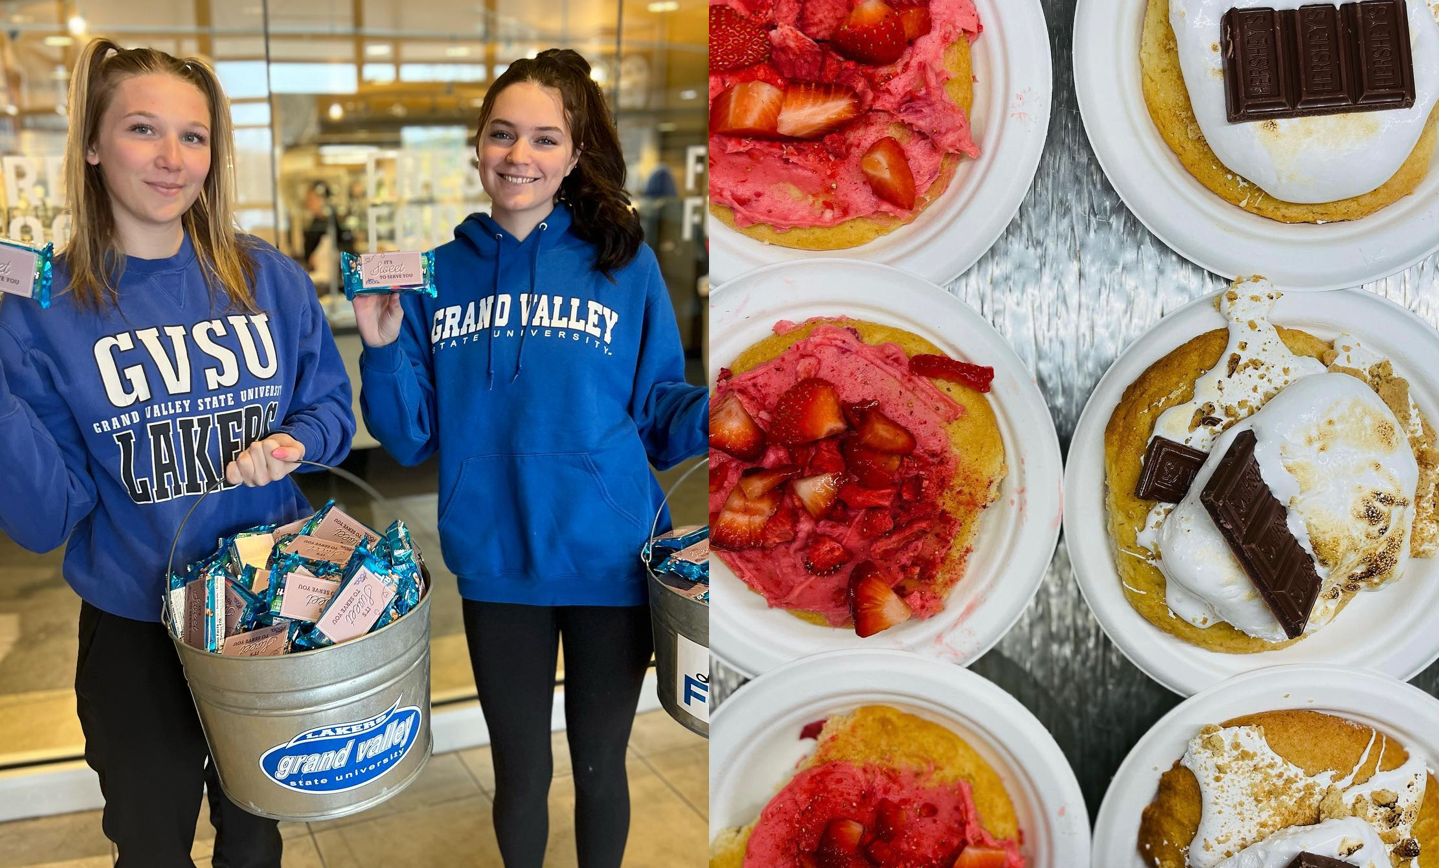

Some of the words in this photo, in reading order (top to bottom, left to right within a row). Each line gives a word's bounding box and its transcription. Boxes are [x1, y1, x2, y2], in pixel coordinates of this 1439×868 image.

[370, 261, 406, 276] Sweet
[431, 293, 512, 345] GRAND
[519, 293, 619, 346] VALLEY
[93, 312, 278, 408] GVSU
[493, 329, 610, 355] UNIVERSITY
[93, 410, 140, 434] GRAND
[145, 400, 191, 419] VALLEY
[198, 393, 234, 411] STATE
[342, 596, 355, 613] SERVE
[345, 584, 375, 627] Sweet
[274, 738, 356, 780] grand
[356, 711, 416, 764] valley
[305, 714, 387, 740] LAKERS
[290, 777, 328, 788] state
[336, 747, 405, 783] university
